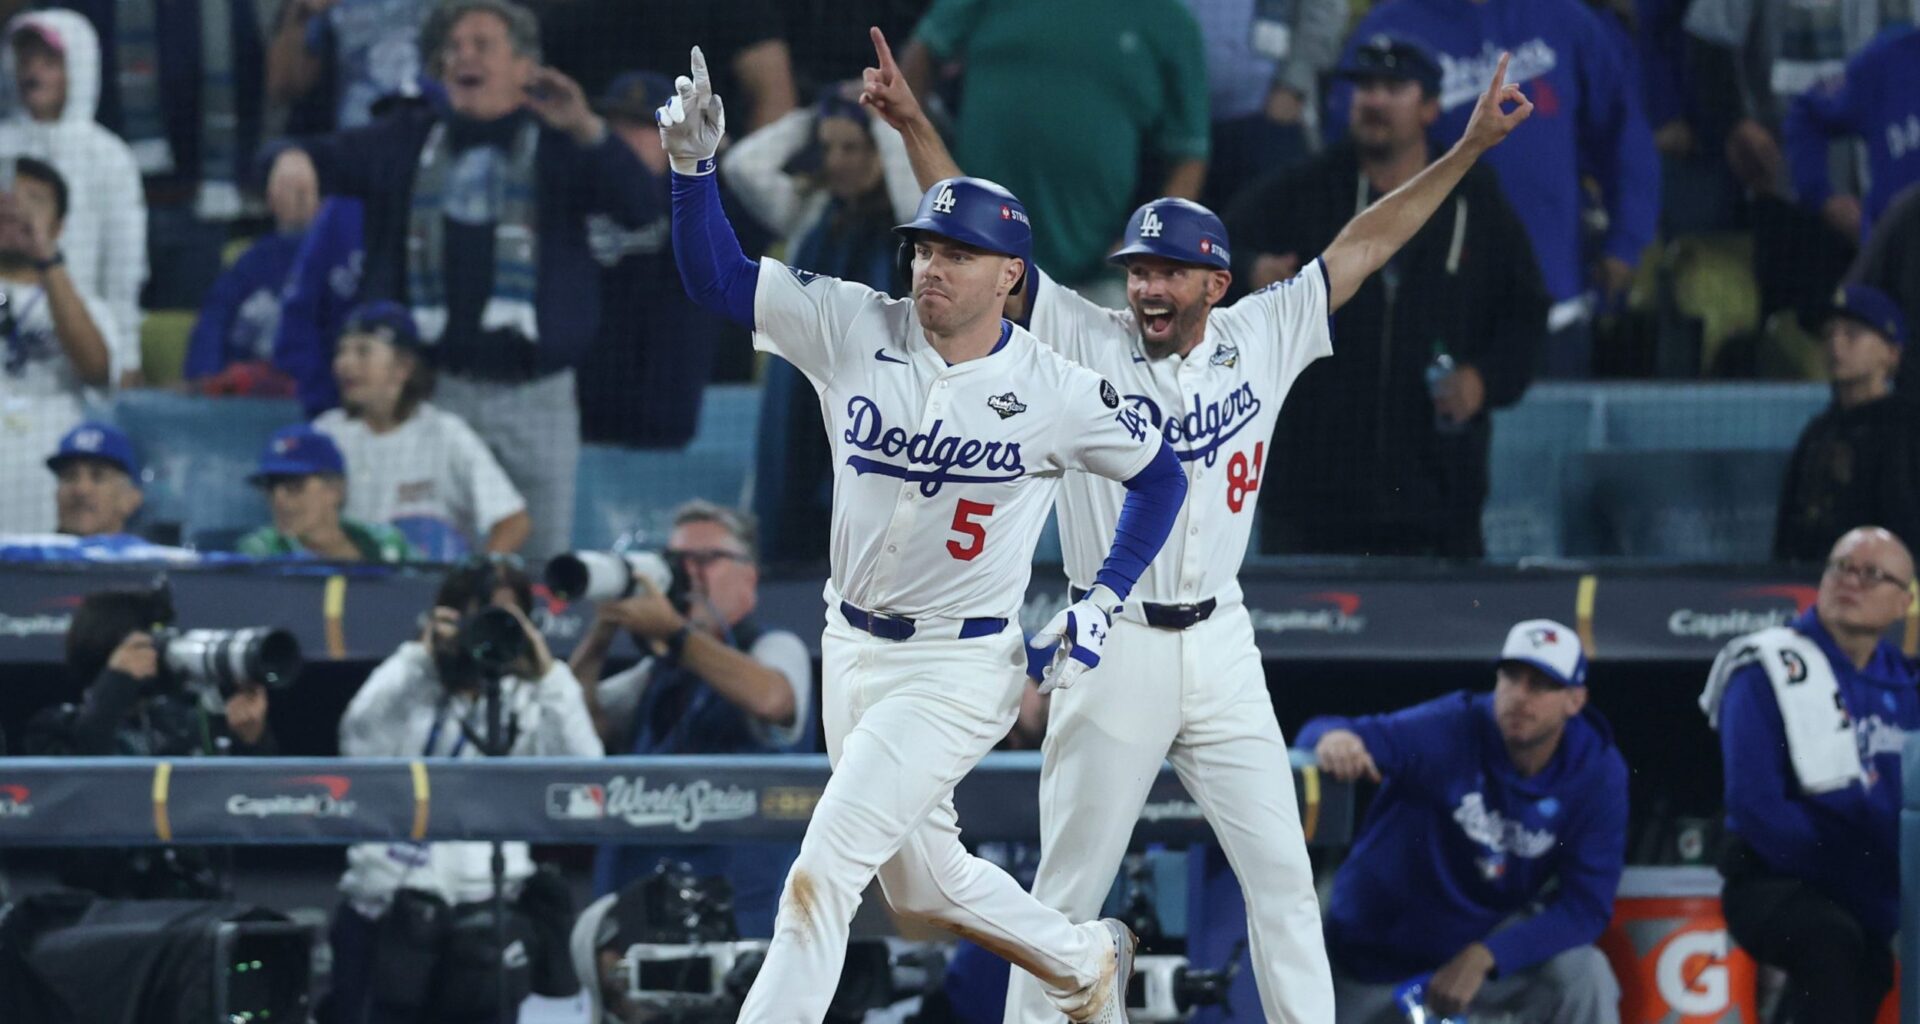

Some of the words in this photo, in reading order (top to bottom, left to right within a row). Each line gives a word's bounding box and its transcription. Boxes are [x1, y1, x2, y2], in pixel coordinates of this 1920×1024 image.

[705, 159, 714, 170] 5
[932, 182, 956, 214] LA
[1140, 207, 1163, 237] LA
[844, 395, 1026, 498] Dodgers
[1115, 408, 1147, 443] LA
[1226, 441, 1264, 514] 84
[946, 498, 995, 561] 5
[1656, 930, 1730, 1016] G
